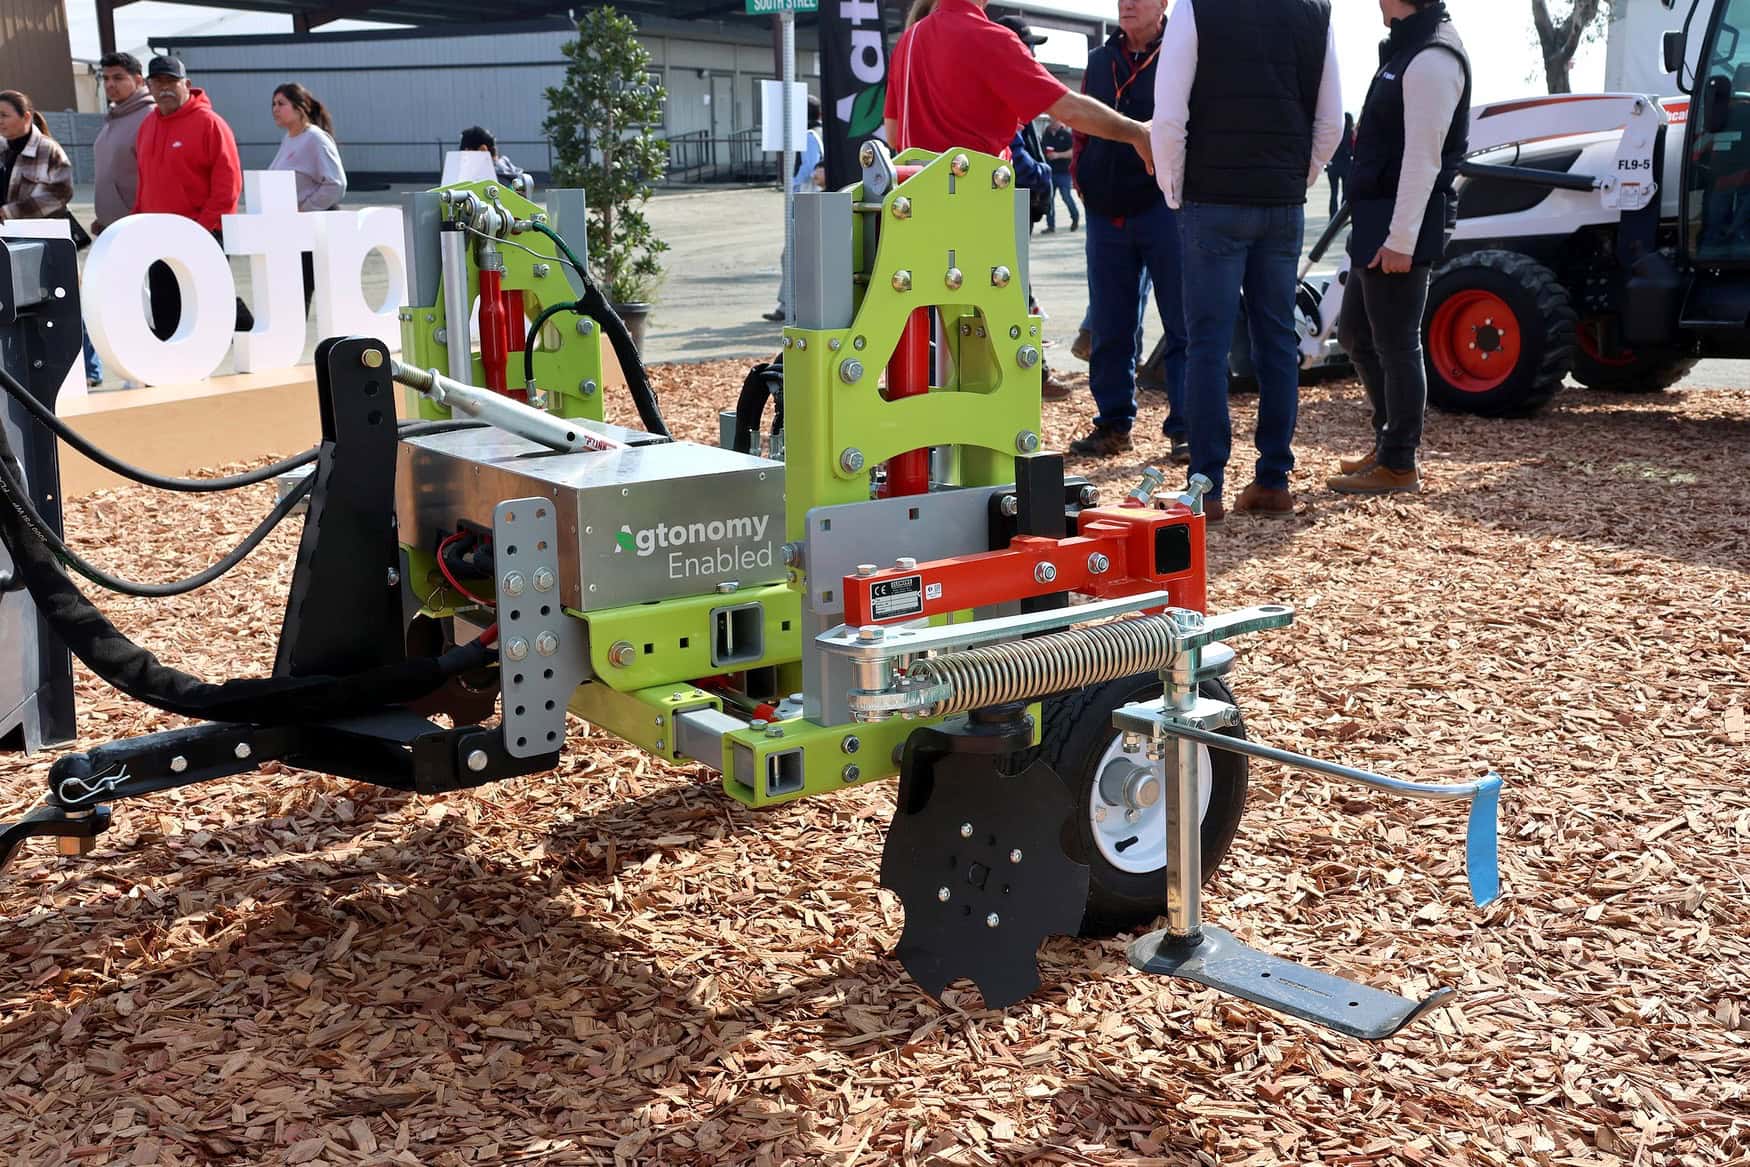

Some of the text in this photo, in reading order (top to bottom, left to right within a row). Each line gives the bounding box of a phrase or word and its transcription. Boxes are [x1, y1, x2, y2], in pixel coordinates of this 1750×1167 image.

[1618, 160, 1650, 170] FL9-5
[614, 514, 769, 556] Agtonomy
[668, 540, 773, 579] Enabled
